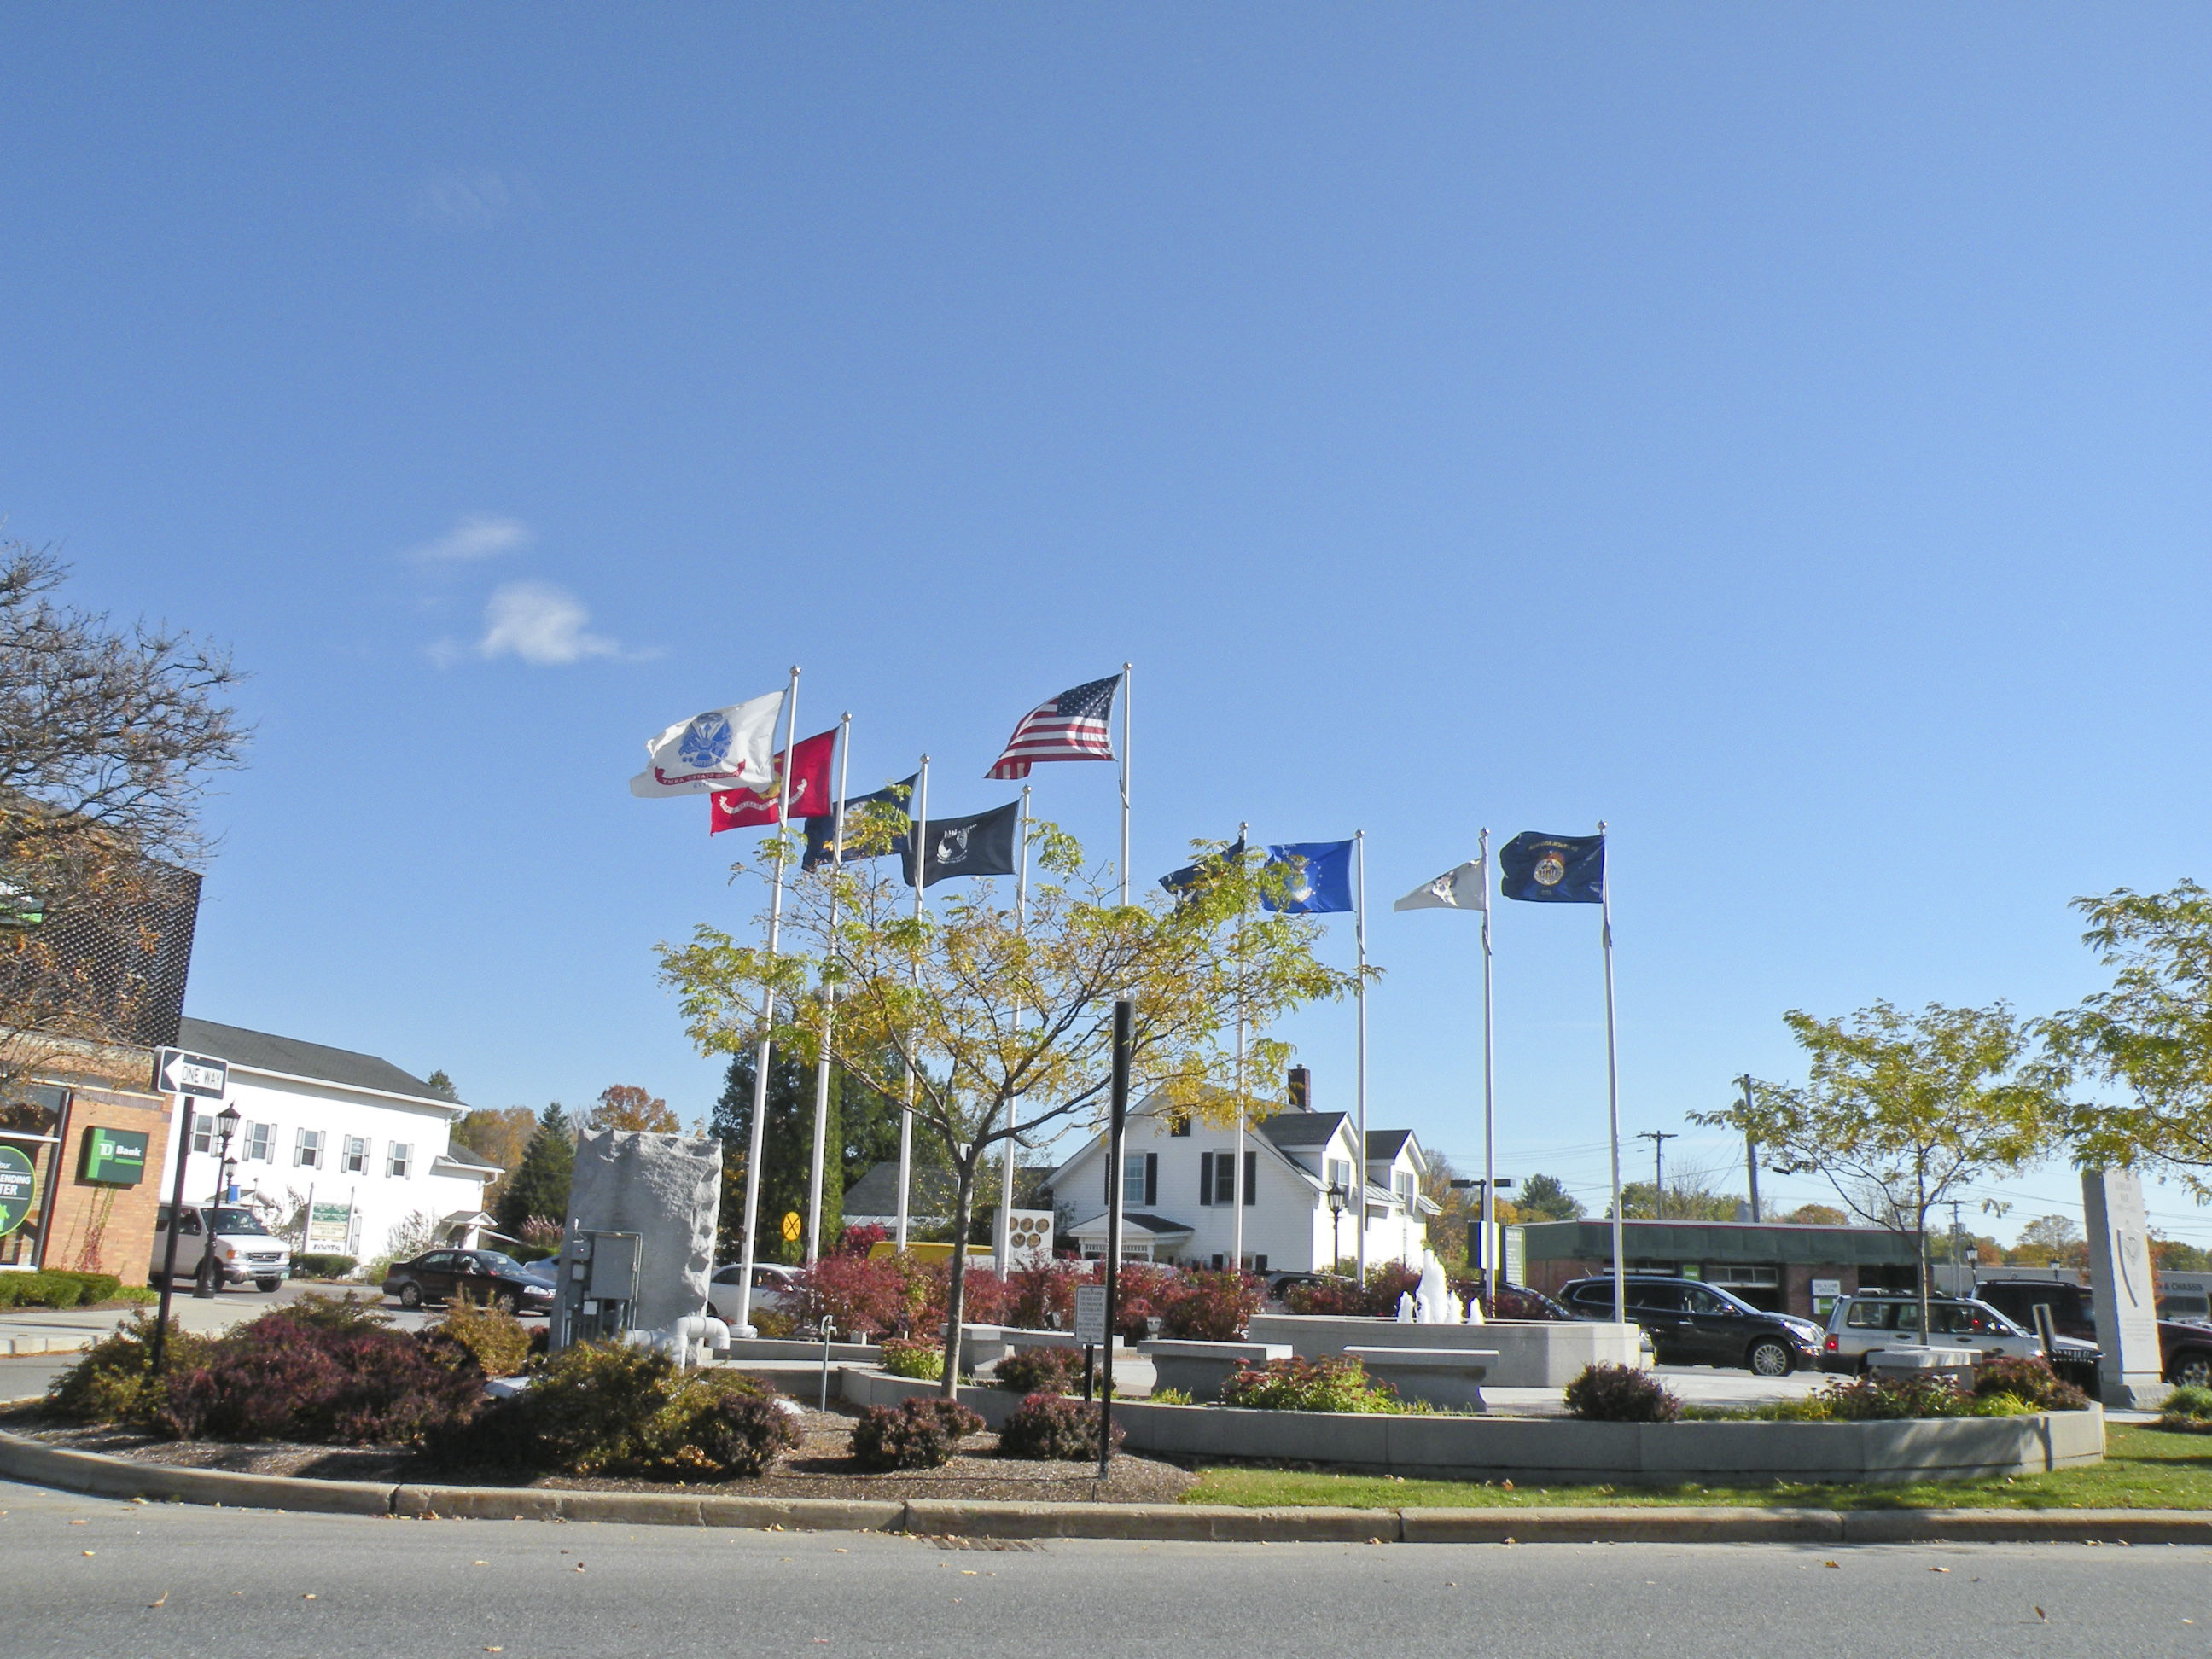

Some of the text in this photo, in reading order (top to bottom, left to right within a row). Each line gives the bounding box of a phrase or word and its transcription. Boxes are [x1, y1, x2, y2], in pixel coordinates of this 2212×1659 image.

[182, 1065, 222, 1087] ONE WAY
[98, 1143, 142, 1157] TD Bank
[2171, 1282, 2203, 1291] CHASSIS
